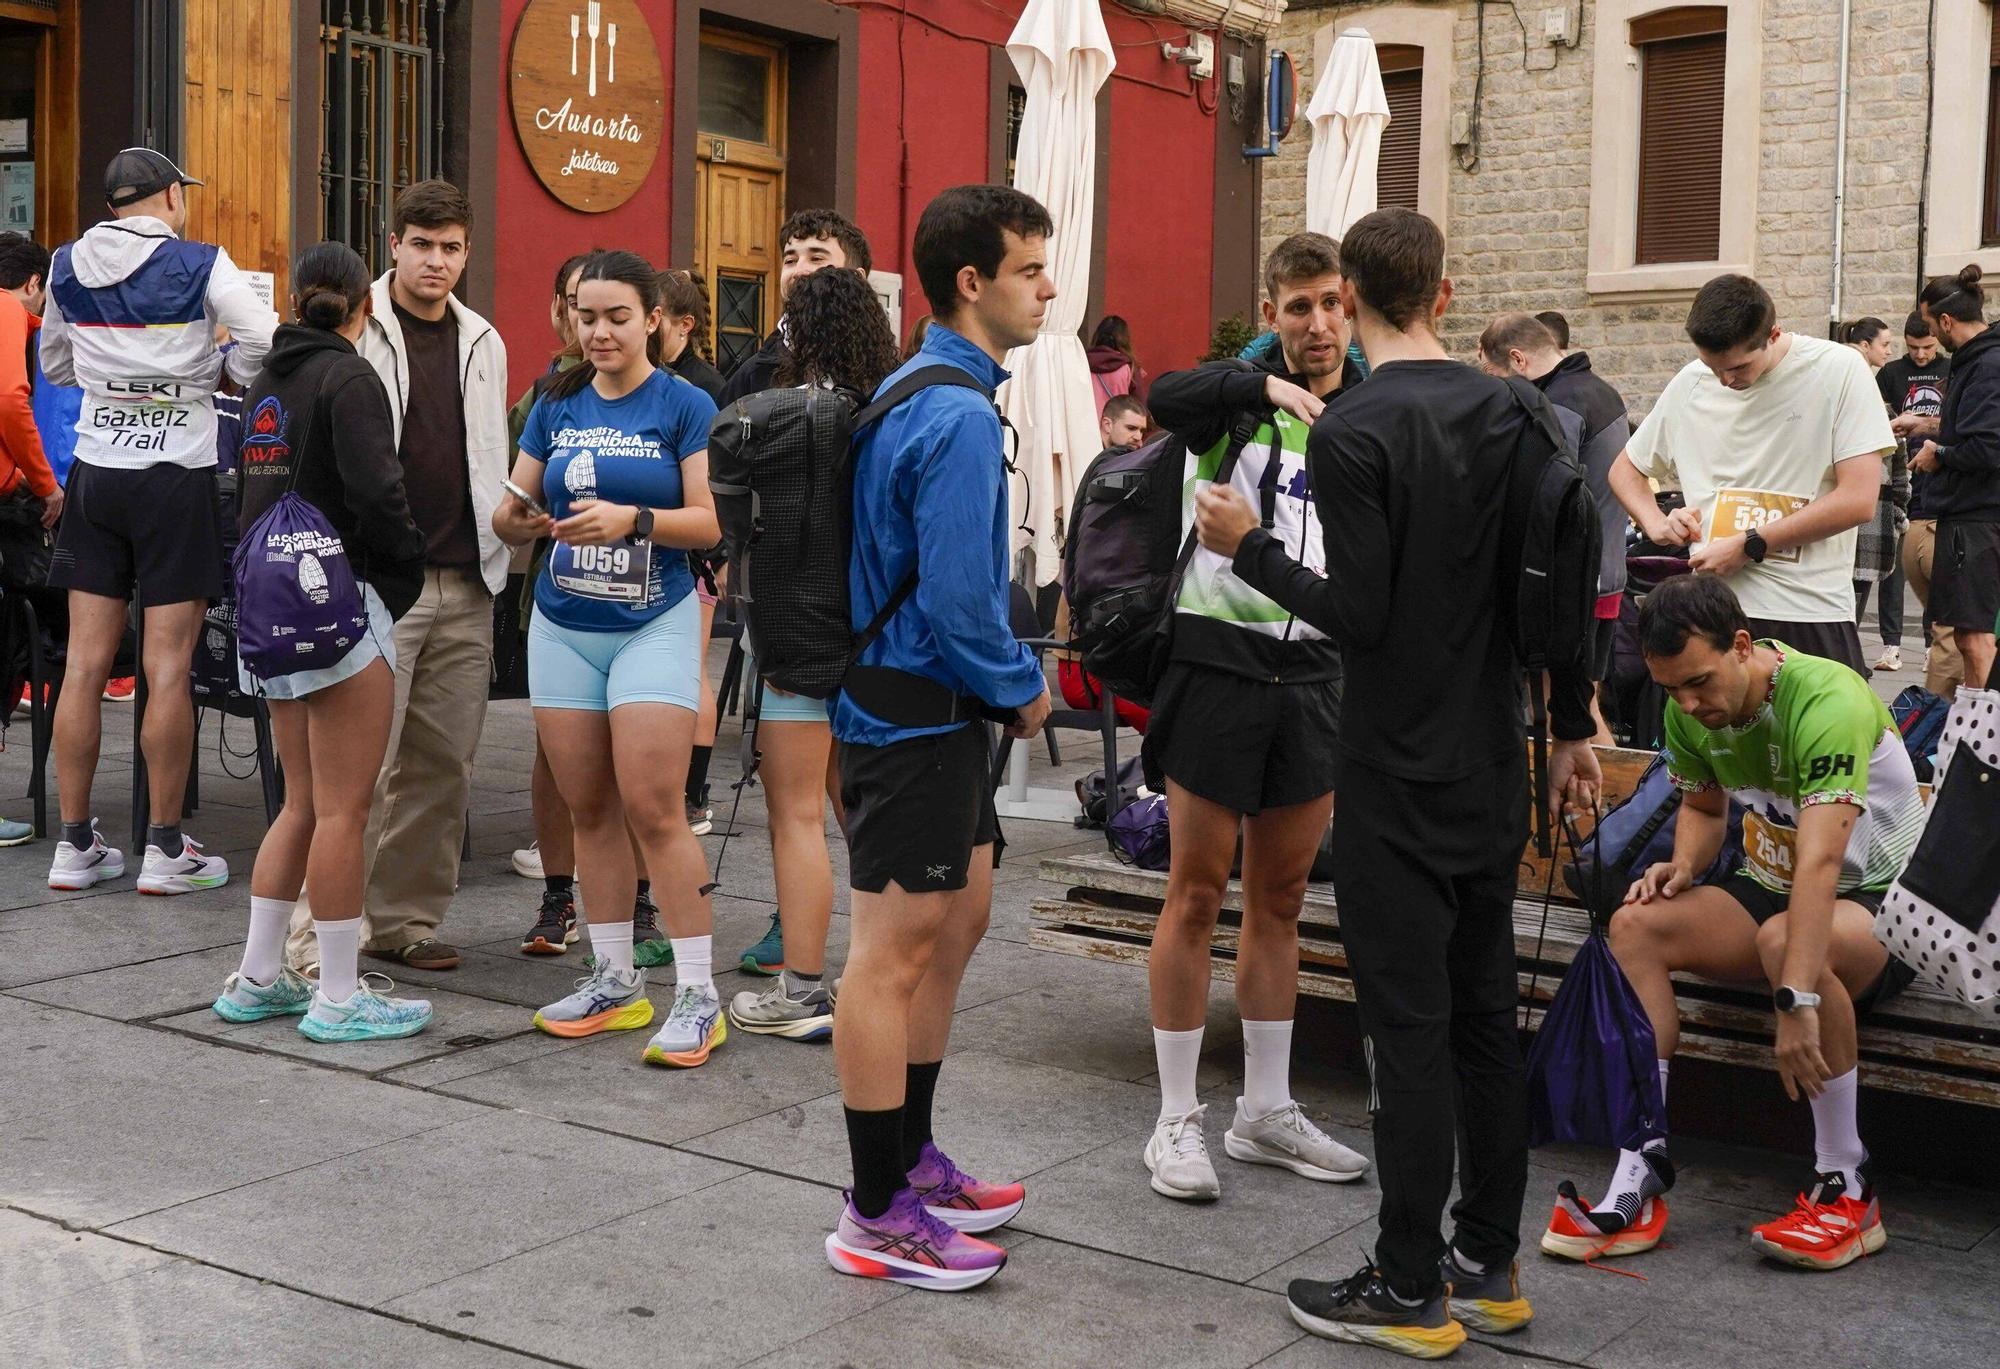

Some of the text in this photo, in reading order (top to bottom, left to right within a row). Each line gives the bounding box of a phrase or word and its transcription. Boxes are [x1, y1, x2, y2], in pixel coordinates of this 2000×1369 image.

[536, 98, 642, 143] Ausarta
[716, 143, 723, 156] 2
[106, 382, 182, 398] LEKI
[111, 429, 166, 451] Trail
[562, 427, 622, 438] CONQUISTA
[557, 434, 643, 448] ALMENDRA
[597, 448, 662, 459] KONKISTA
[268, 533, 280, 543] LA
[571, 544, 630, 574] 1059
[583, 572, 613, 582] ESTIBALIZ
[1808, 754, 1855, 781] BH
[1756, 831, 1793, 872] 254
